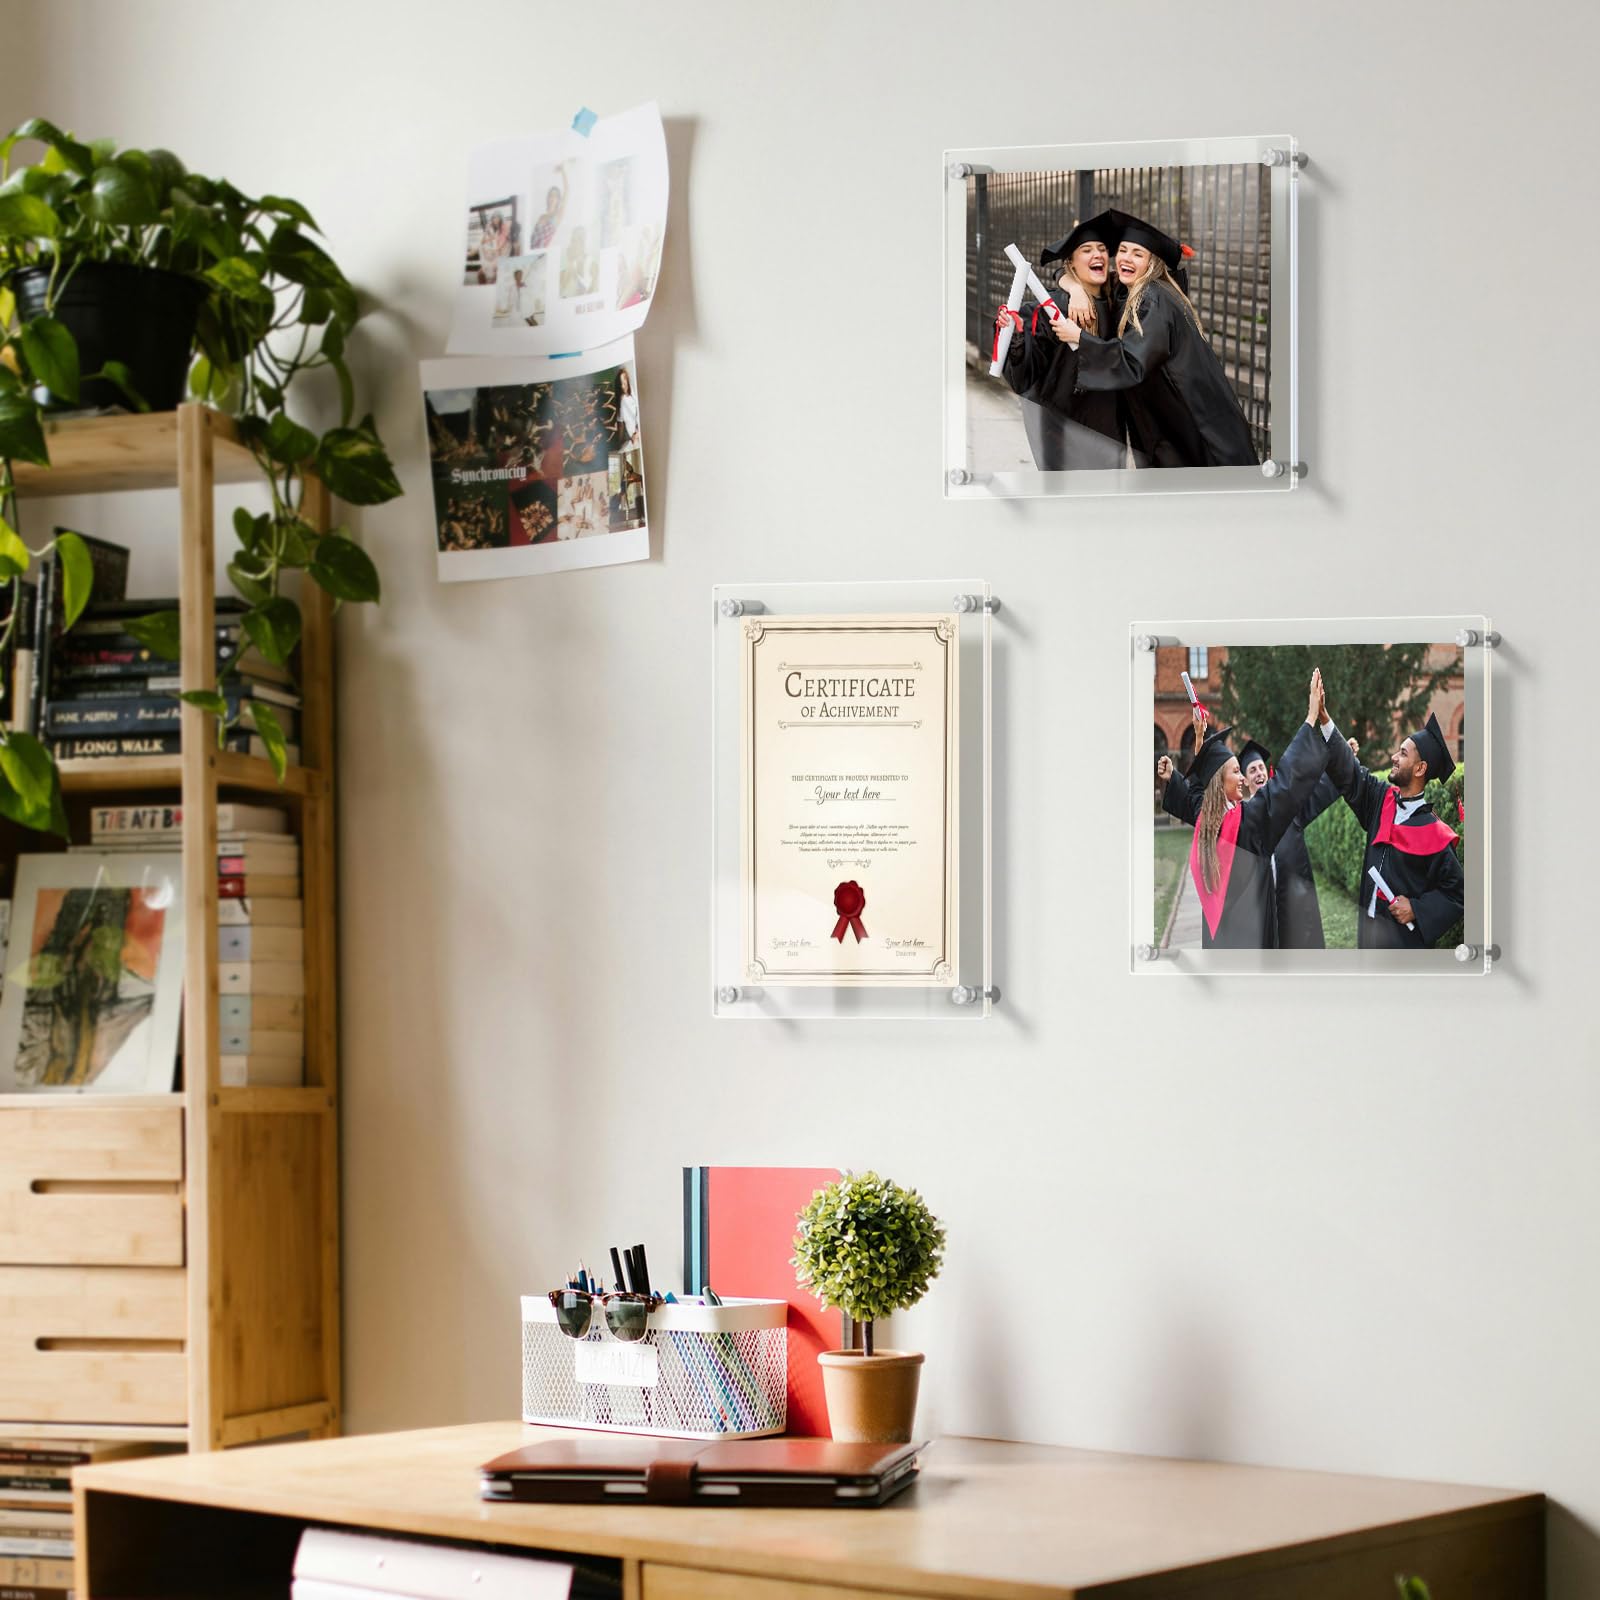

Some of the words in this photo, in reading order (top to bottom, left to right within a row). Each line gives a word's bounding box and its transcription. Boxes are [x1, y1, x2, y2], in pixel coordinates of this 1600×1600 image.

[450, 464, 527, 485] Synchronicity
[55, 711, 79, 722] JANE
[74, 740, 118, 754] LONG
[121, 739, 164, 753] WALK
[814, 785, 840, 805] Your
[843, 787, 860, 800] text
[862, 785, 881, 800] here
[771, 937, 787, 950] Your
[800, 937, 811, 948] here
[885, 937, 900, 950] Your
[912, 937, 925, 948] here
